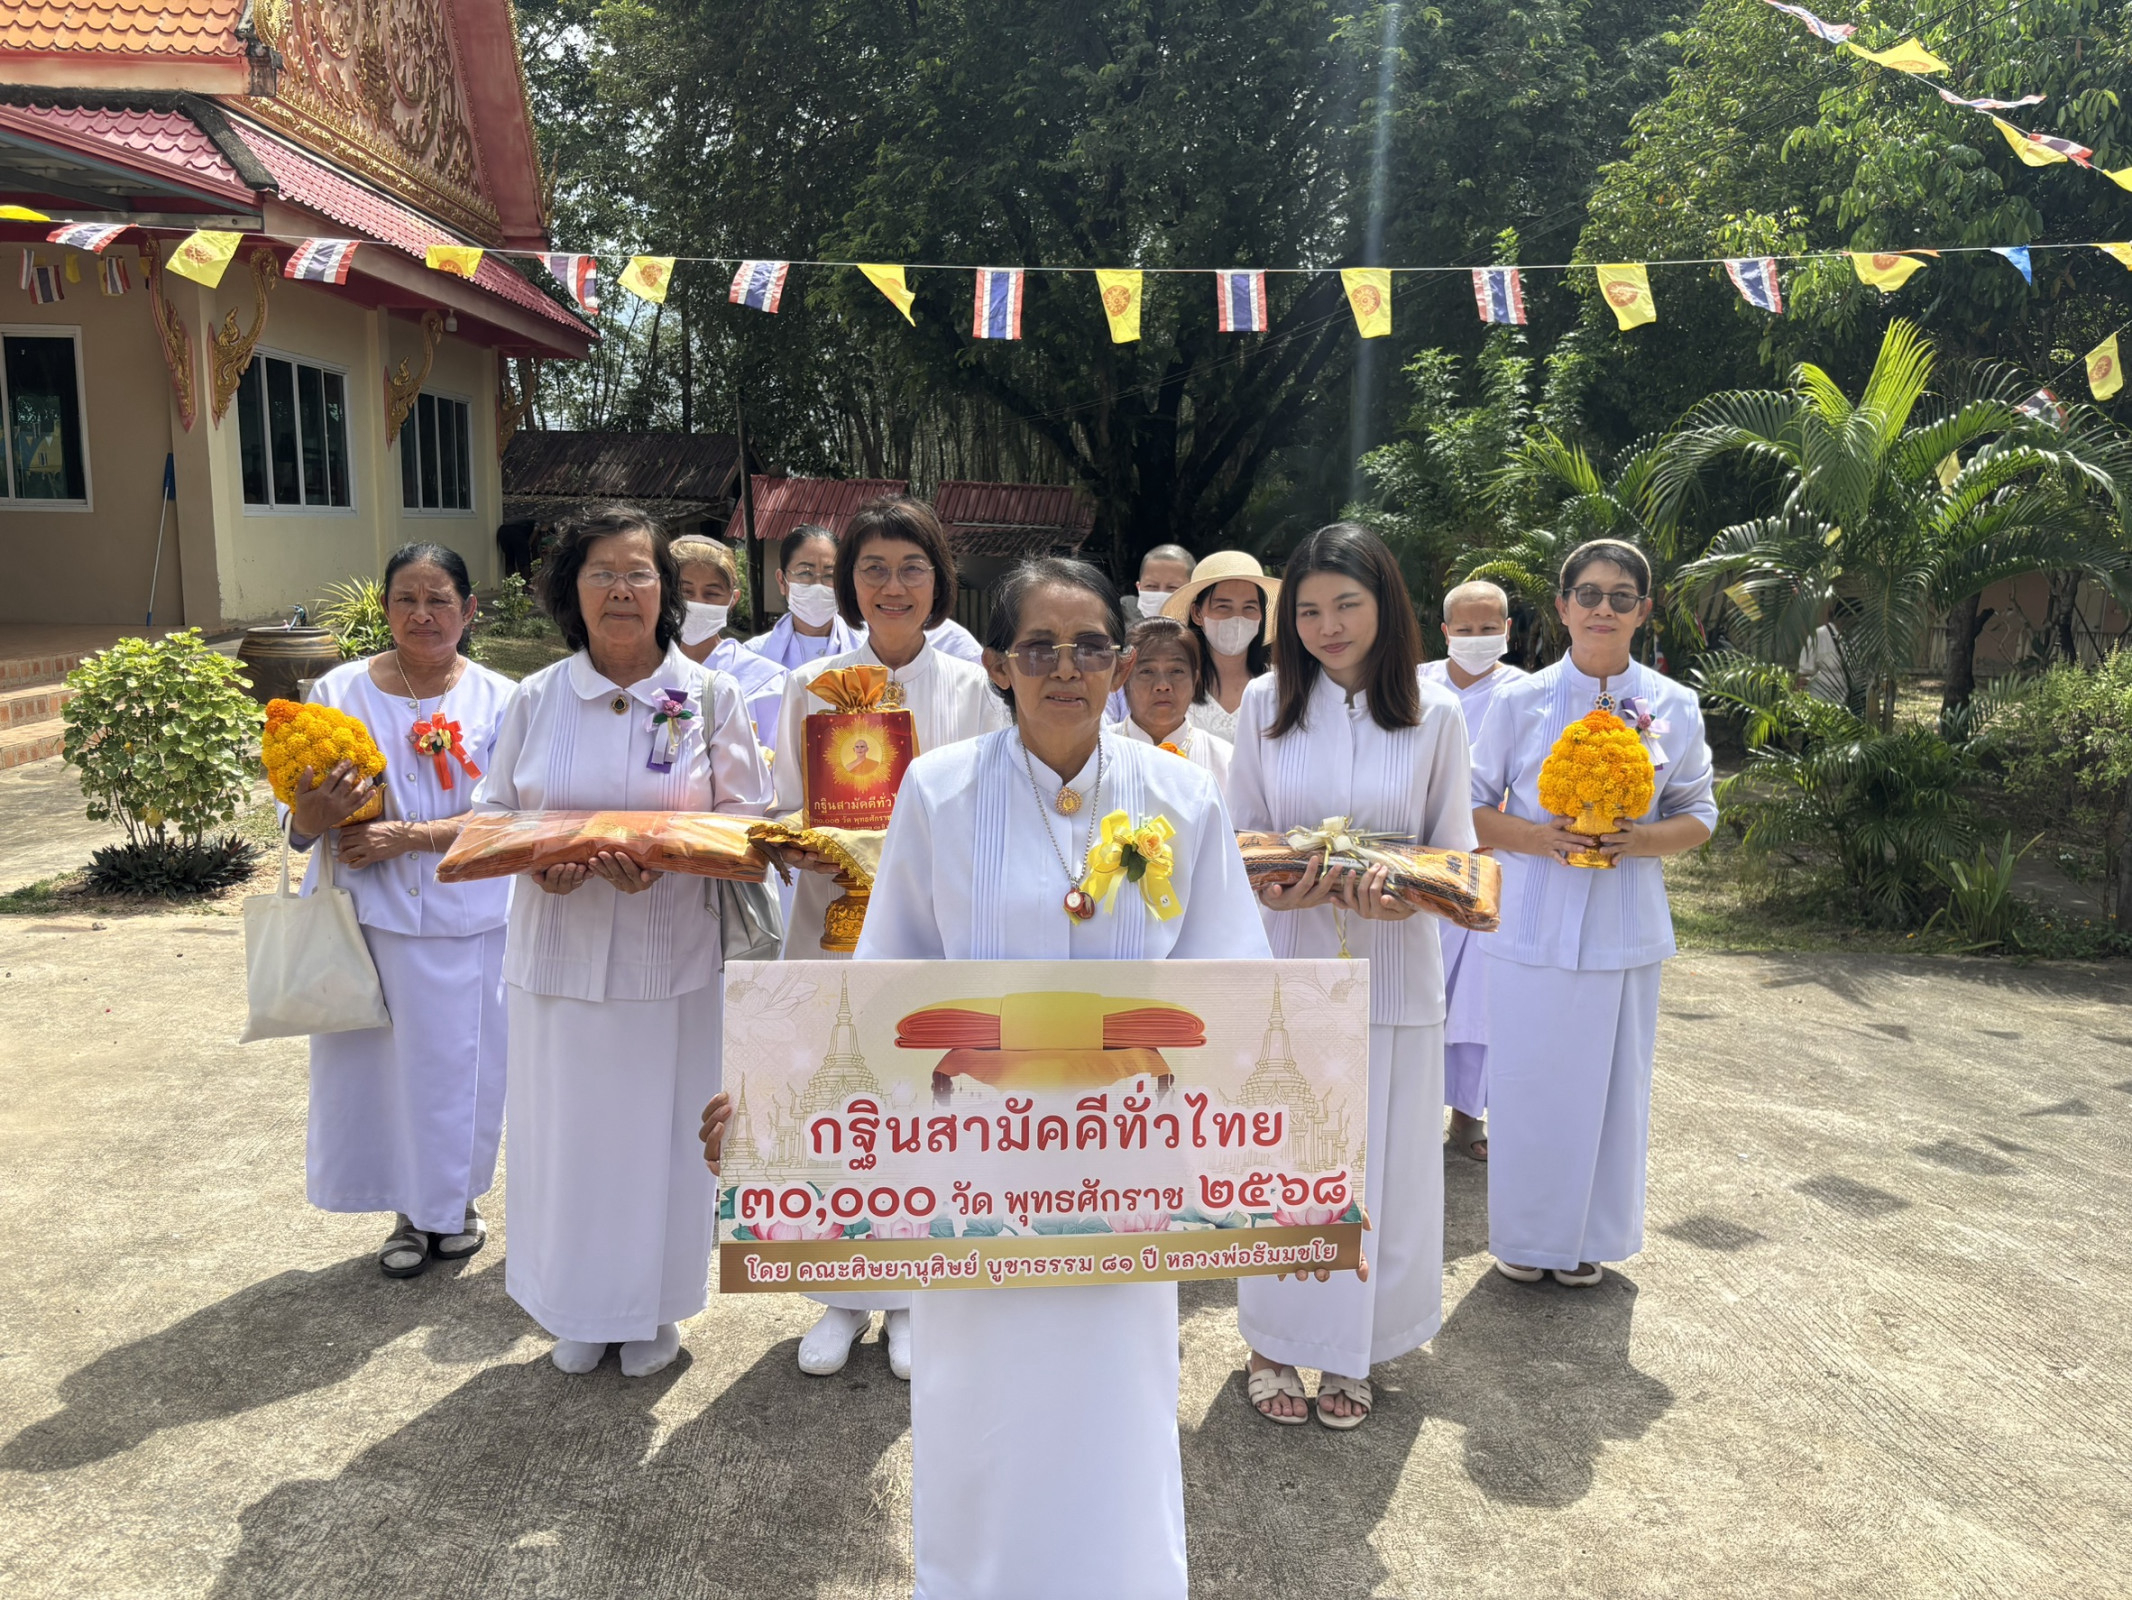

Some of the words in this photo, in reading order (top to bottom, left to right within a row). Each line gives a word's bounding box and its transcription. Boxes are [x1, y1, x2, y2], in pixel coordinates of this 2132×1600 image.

[810, 1079, 1283, 1170] กฐินสามัคคีทั่วไทย
[741, 1185, 937, 1227] ๓๐,๐๐๐
[951, 1180, 993, 1216] วัด
[1004, 1178, 1184, 1227] พุทธศักราช
[1198, 1170, 1347, 1209] ๒๕๖๘
[746, 1256, 790, 1280] โดย
[799, 1251, 978, 1284] คณะศิษยานุศิษย์
[986, 1256, 1093, 1283] บูชาธรรม
[1101, 1255, 1134, 1272] ๘๑
[1142, 1246, 1158, 1270] ปี
[1166, 1239, 1338, 1269] หลวงพ่อธัมมชโย
